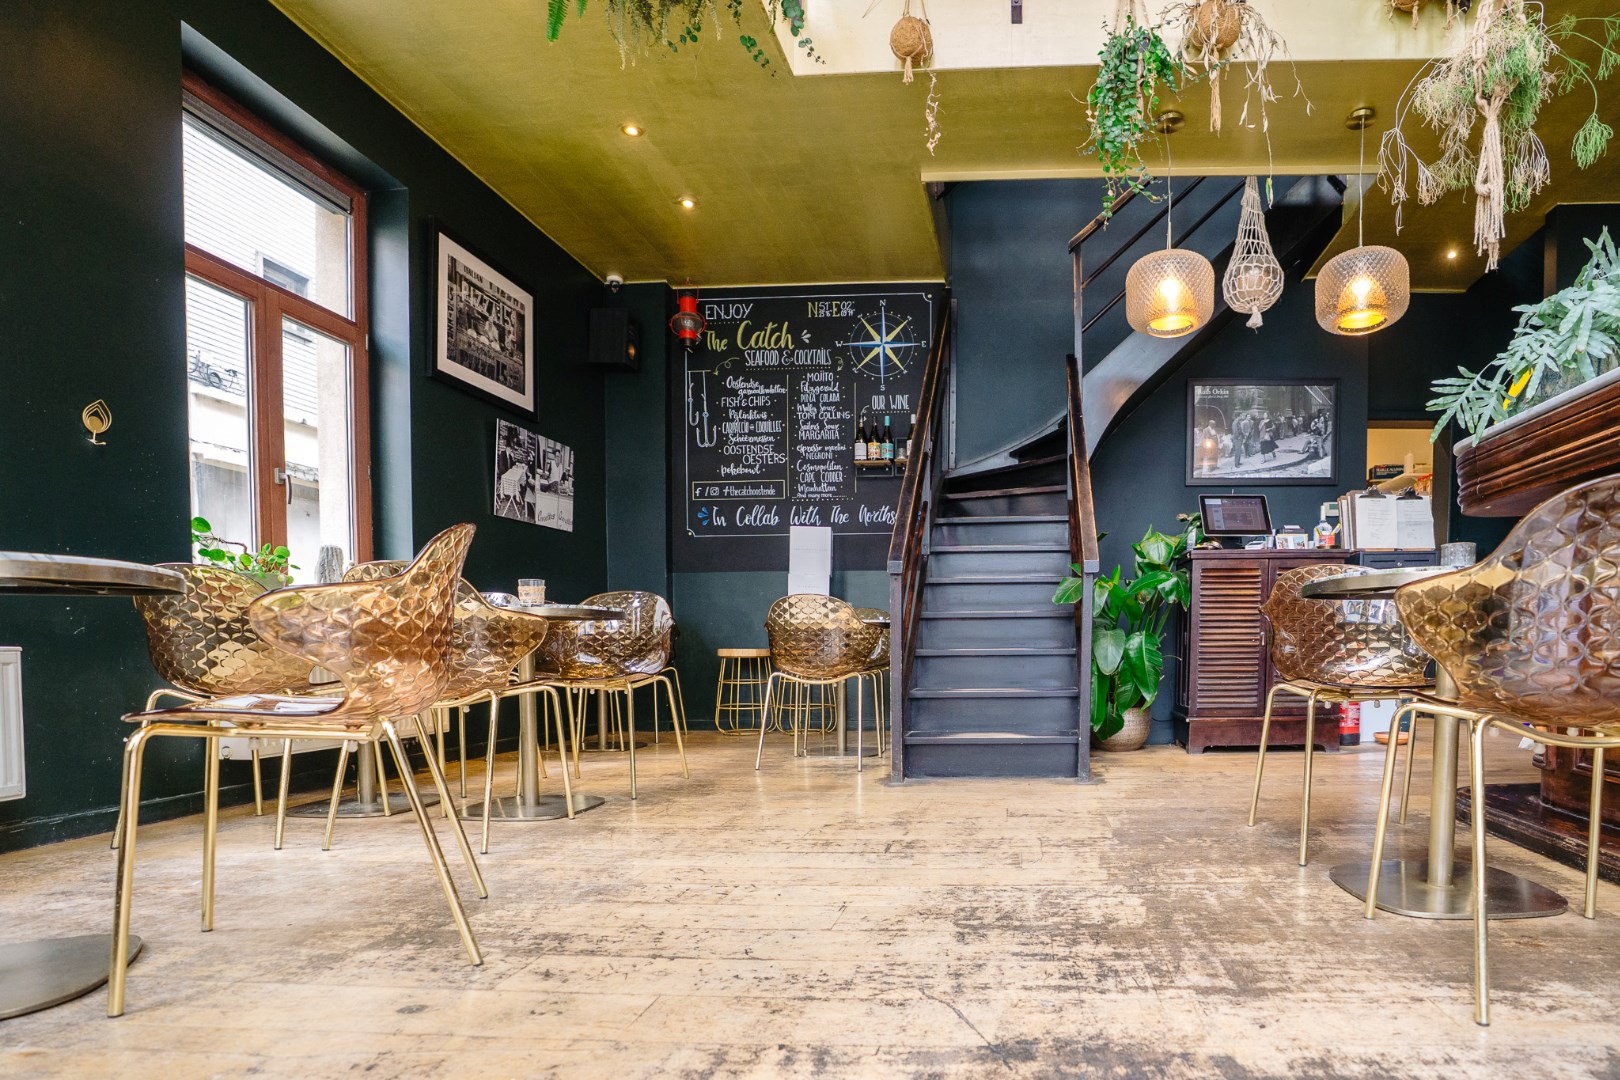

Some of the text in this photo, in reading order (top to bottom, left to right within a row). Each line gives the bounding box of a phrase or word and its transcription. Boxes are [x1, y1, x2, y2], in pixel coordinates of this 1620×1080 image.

[706, 303, 753, 320] ENJOY
[808, 302, 818, 318] N
[832, 302, 840, 317] E
[704, 320, 795, 352] The Catch
[745, 348, 832, 366] SEAFOOD & COCKTAILS
[726, 376, 759, 389] Oostendse
[801, 381, 839, 395] Fitzgerald
[721, 397, 740, 407] FISH
[749, 396, 770, 406] CHIPS
[820, 393, 840, 402] COLADA
[872, 395, 909, 410] OUR WINE
[819, 403, 836, 412] Sour
[819, 411, 850, 420] COLLINS
[722, 421, 749, 433] CARPACCIO
[756, 420, 782, 433] COQUILLES
[824, 418, 840, 430] Sour
[799, 430, 840, 440] MARGARITA
[724, 444, 774, 455] OOSTENDSE
[742, 453, 786, 464] OESTERS
[721, 463, 760, 477] pokebowl
[796, 460, 843, 472] Cosmopolitan
[800, 471, 843, 483] CAPE CODDER
[798, 483, 837, 492] Manhattan
[712, 504, 897, 526] In Collab With The Norths
